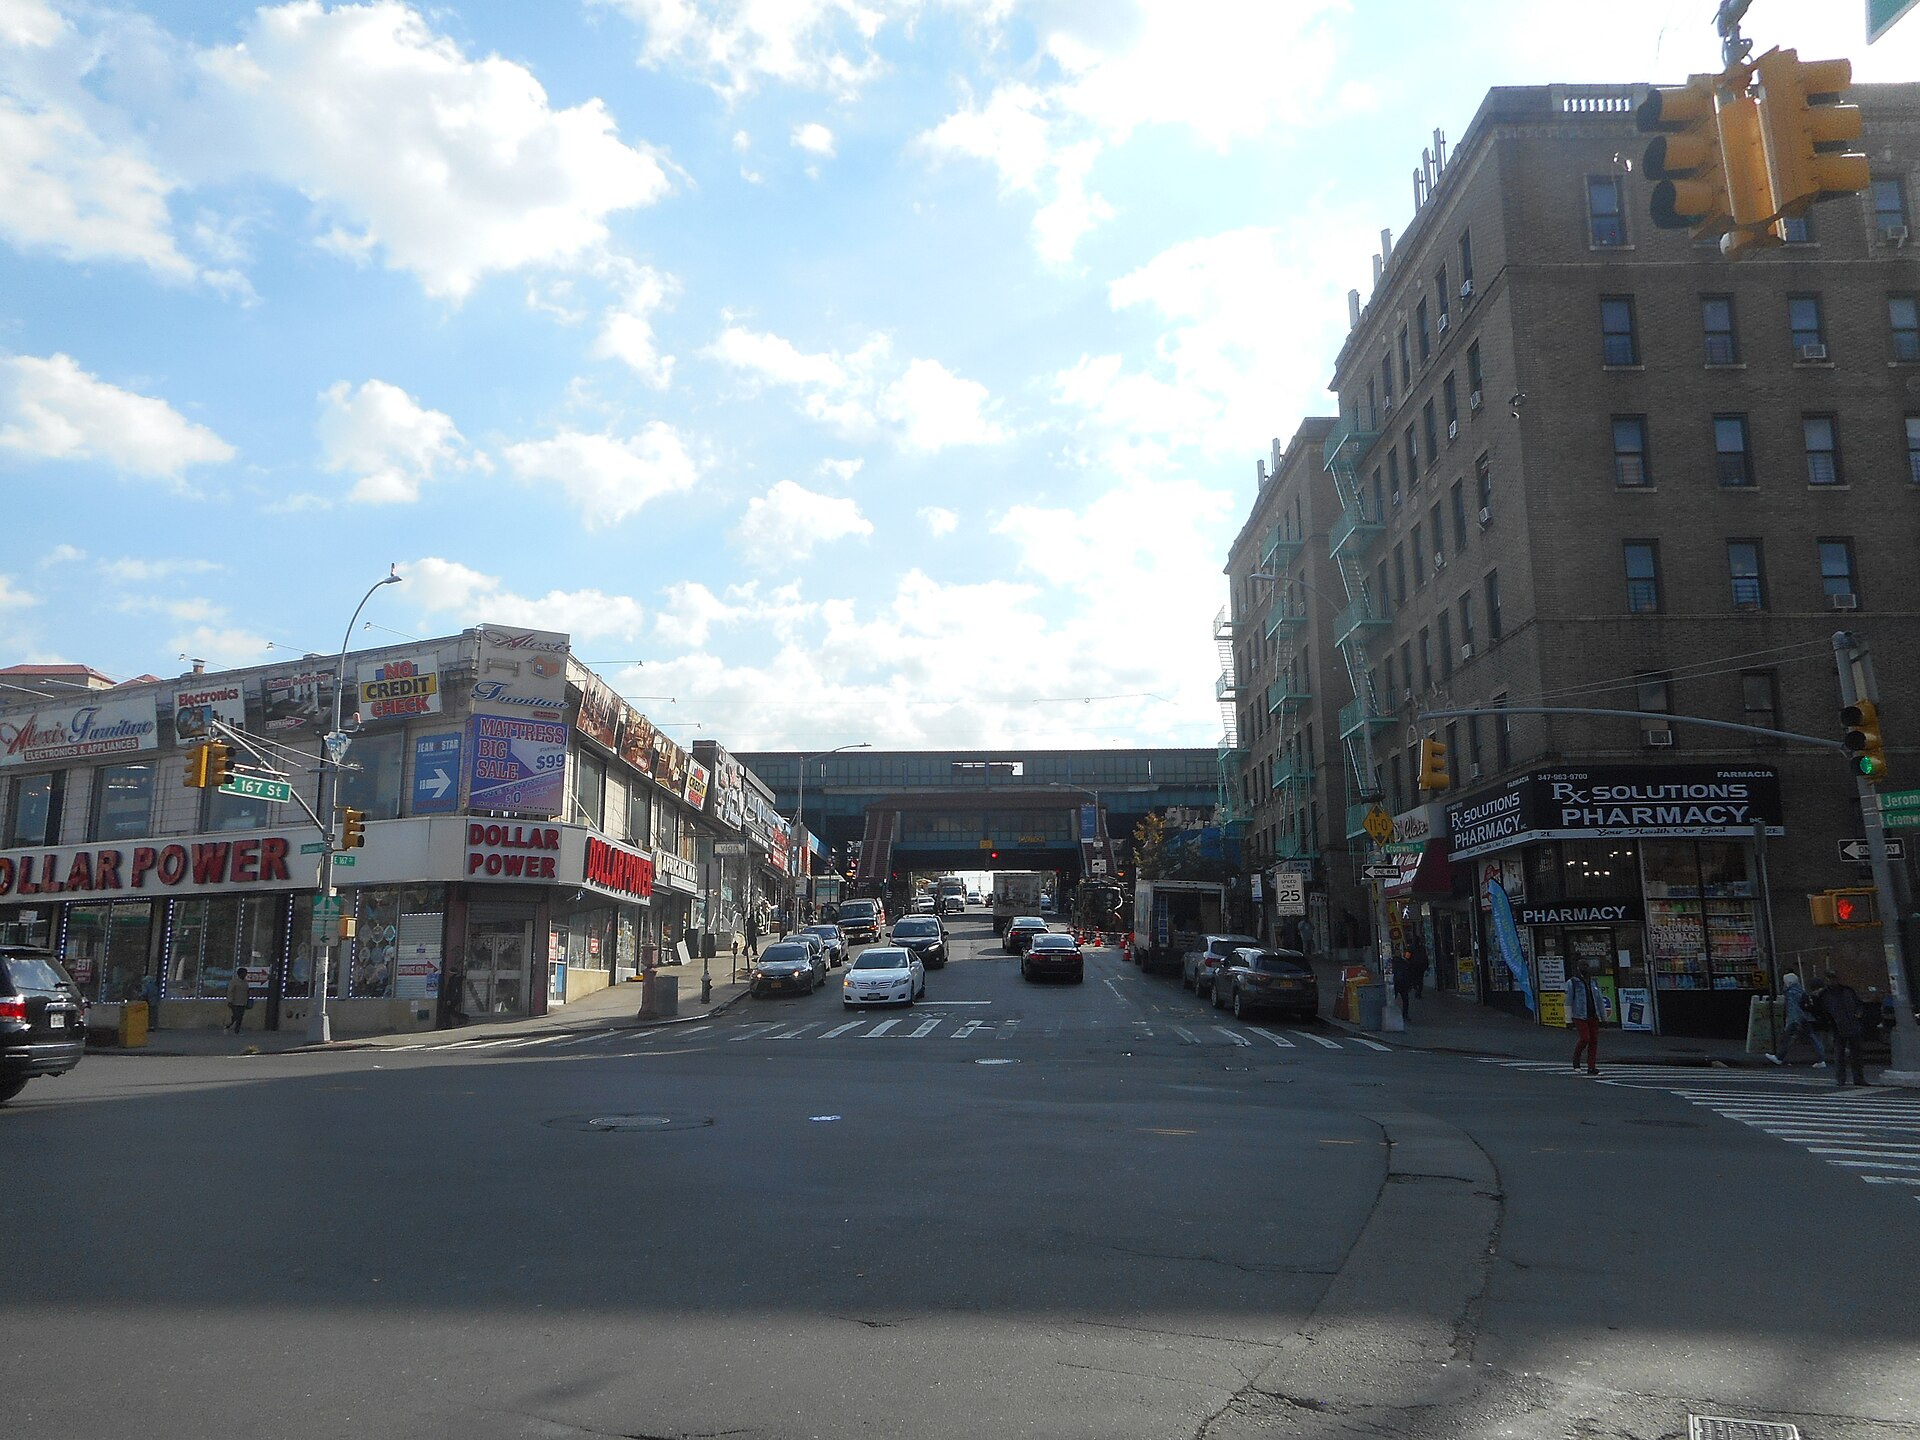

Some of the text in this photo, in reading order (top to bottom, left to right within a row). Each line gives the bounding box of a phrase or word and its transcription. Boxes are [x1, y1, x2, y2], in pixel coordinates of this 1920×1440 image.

[481, 630, 571, 653] Alexis
[384, 660, 413, 679] NO
[179, 688, 238, 707] Electronics
[366, 677, 429, 699] CREDIT
[471, 681, 569, 709] Furniture
[371, 695, 430, 717] CHECK
[0, 707, 153, 755] Alexis Furniture
[480, 718, 566, 745] MATTRESS
[26, 739, 137, 760] ELECTRONICS & APPLIANCES
[442, 740, 458, 750] STAR
[479, 739, 507, 759] BIG
[477, 759, 519, 780] SALE
[536, 754, 565, 770] $99
[241, 780, 263, 794] 167
[267, 784, 281, 797] St
[1592, 784, 1748, 800] SOLUTIONS
[1463, 792, 1520, 823] SOLUTIONS
[1562, 805, 1749, 826] PHARMACY
[469, 823, 560, 850] DOLLAR
[1455, 814, 1521, 849] PHARMACY
[131, 838, 290, 888] POWER
[339, 856, 348, 865] 167
[468, 852, 556, 879] POWER
[587, 836, 653, 897] DOLLAR POWER
[1280, 890, 1301, 902] 25
[1523, 906, 1626, 923] PHARMACY
